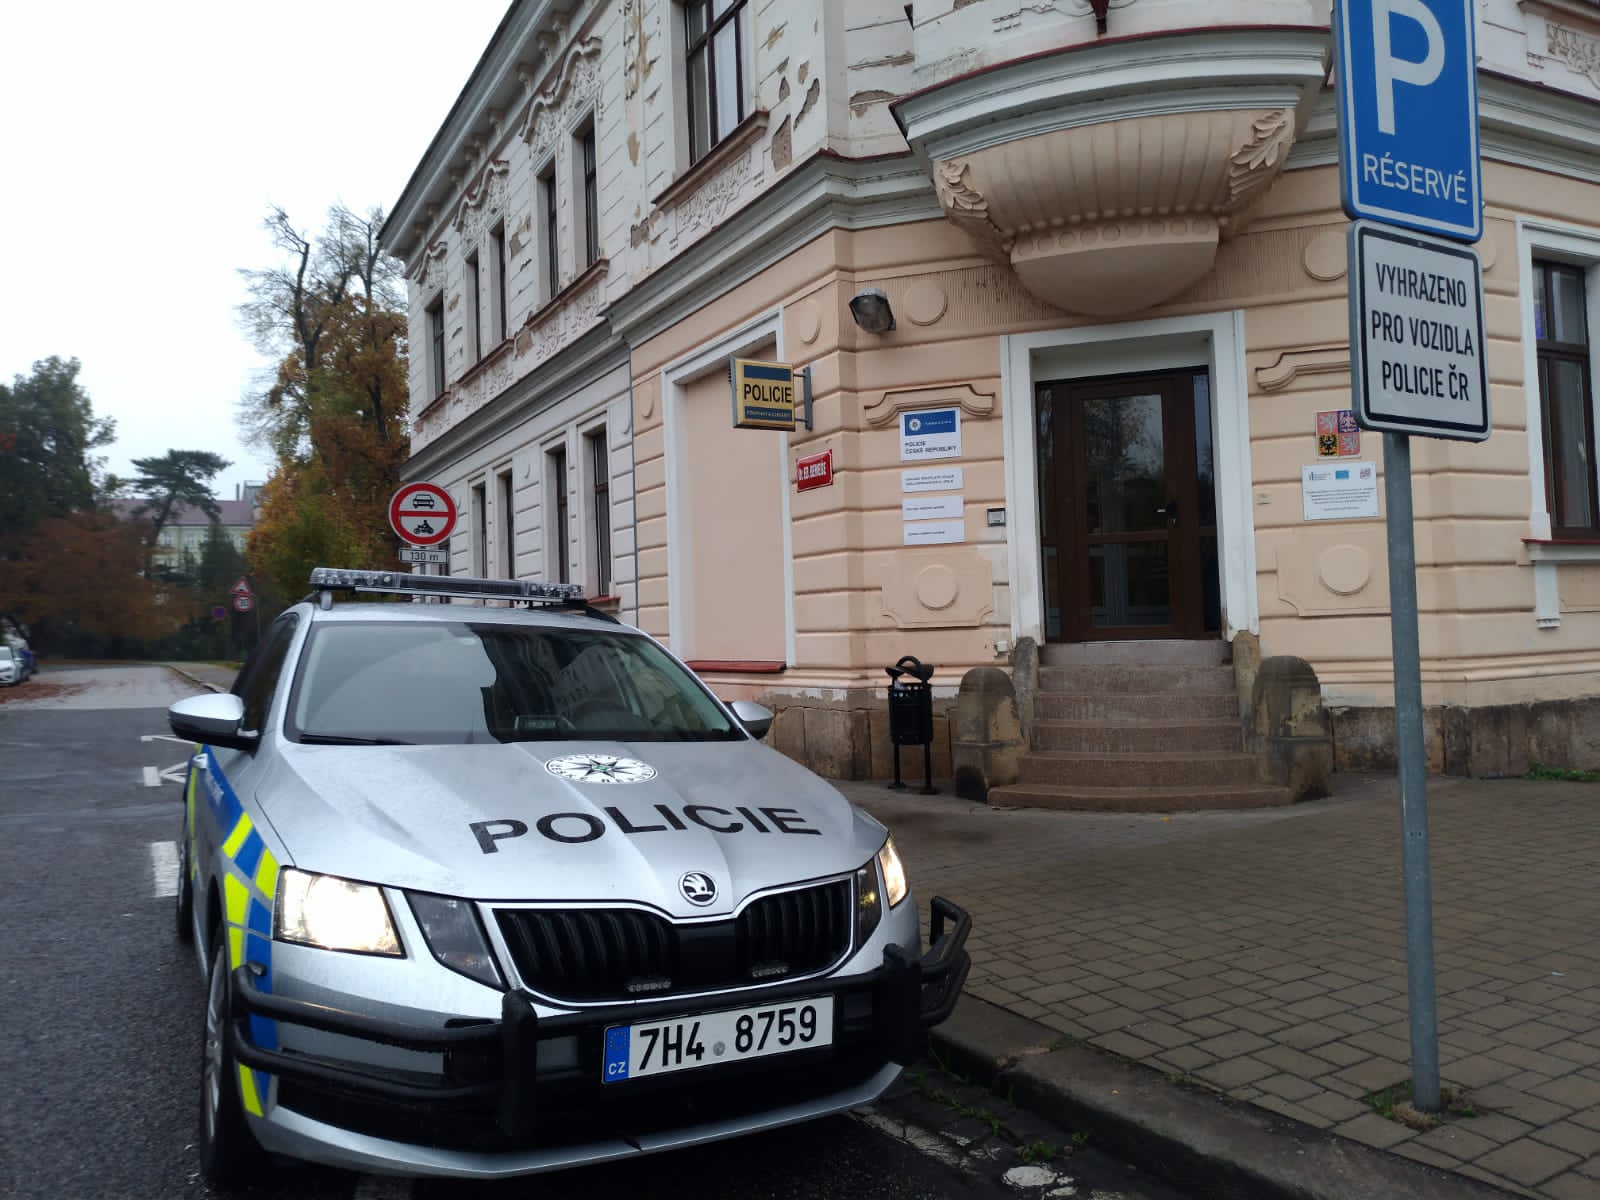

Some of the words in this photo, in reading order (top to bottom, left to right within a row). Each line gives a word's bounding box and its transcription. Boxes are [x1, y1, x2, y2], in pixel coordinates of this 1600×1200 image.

[1371, 0, 1445, 136] P
[1363, 152, 1467, 205] RÉSERVÉ
[1376, 262, 1467, 308] VYHRAZENO
[1372, 309, 1404, 344] PRO
[1409, 317, 1474, 357] VOZIDLA
[744, 383, 792, 403] POLICIE
[1382, 360, 1444, 398] POLICIE
[1449, 364, 1470, 401] ČR
[410, 551, 426, 561] 130
[469, 804, 823, 854] POLICIE
[638, 1021, 705, 1071] 7H4
[735, 1005, 817, 1053] 8759
[608, 1061, 627, 1076] CZ
